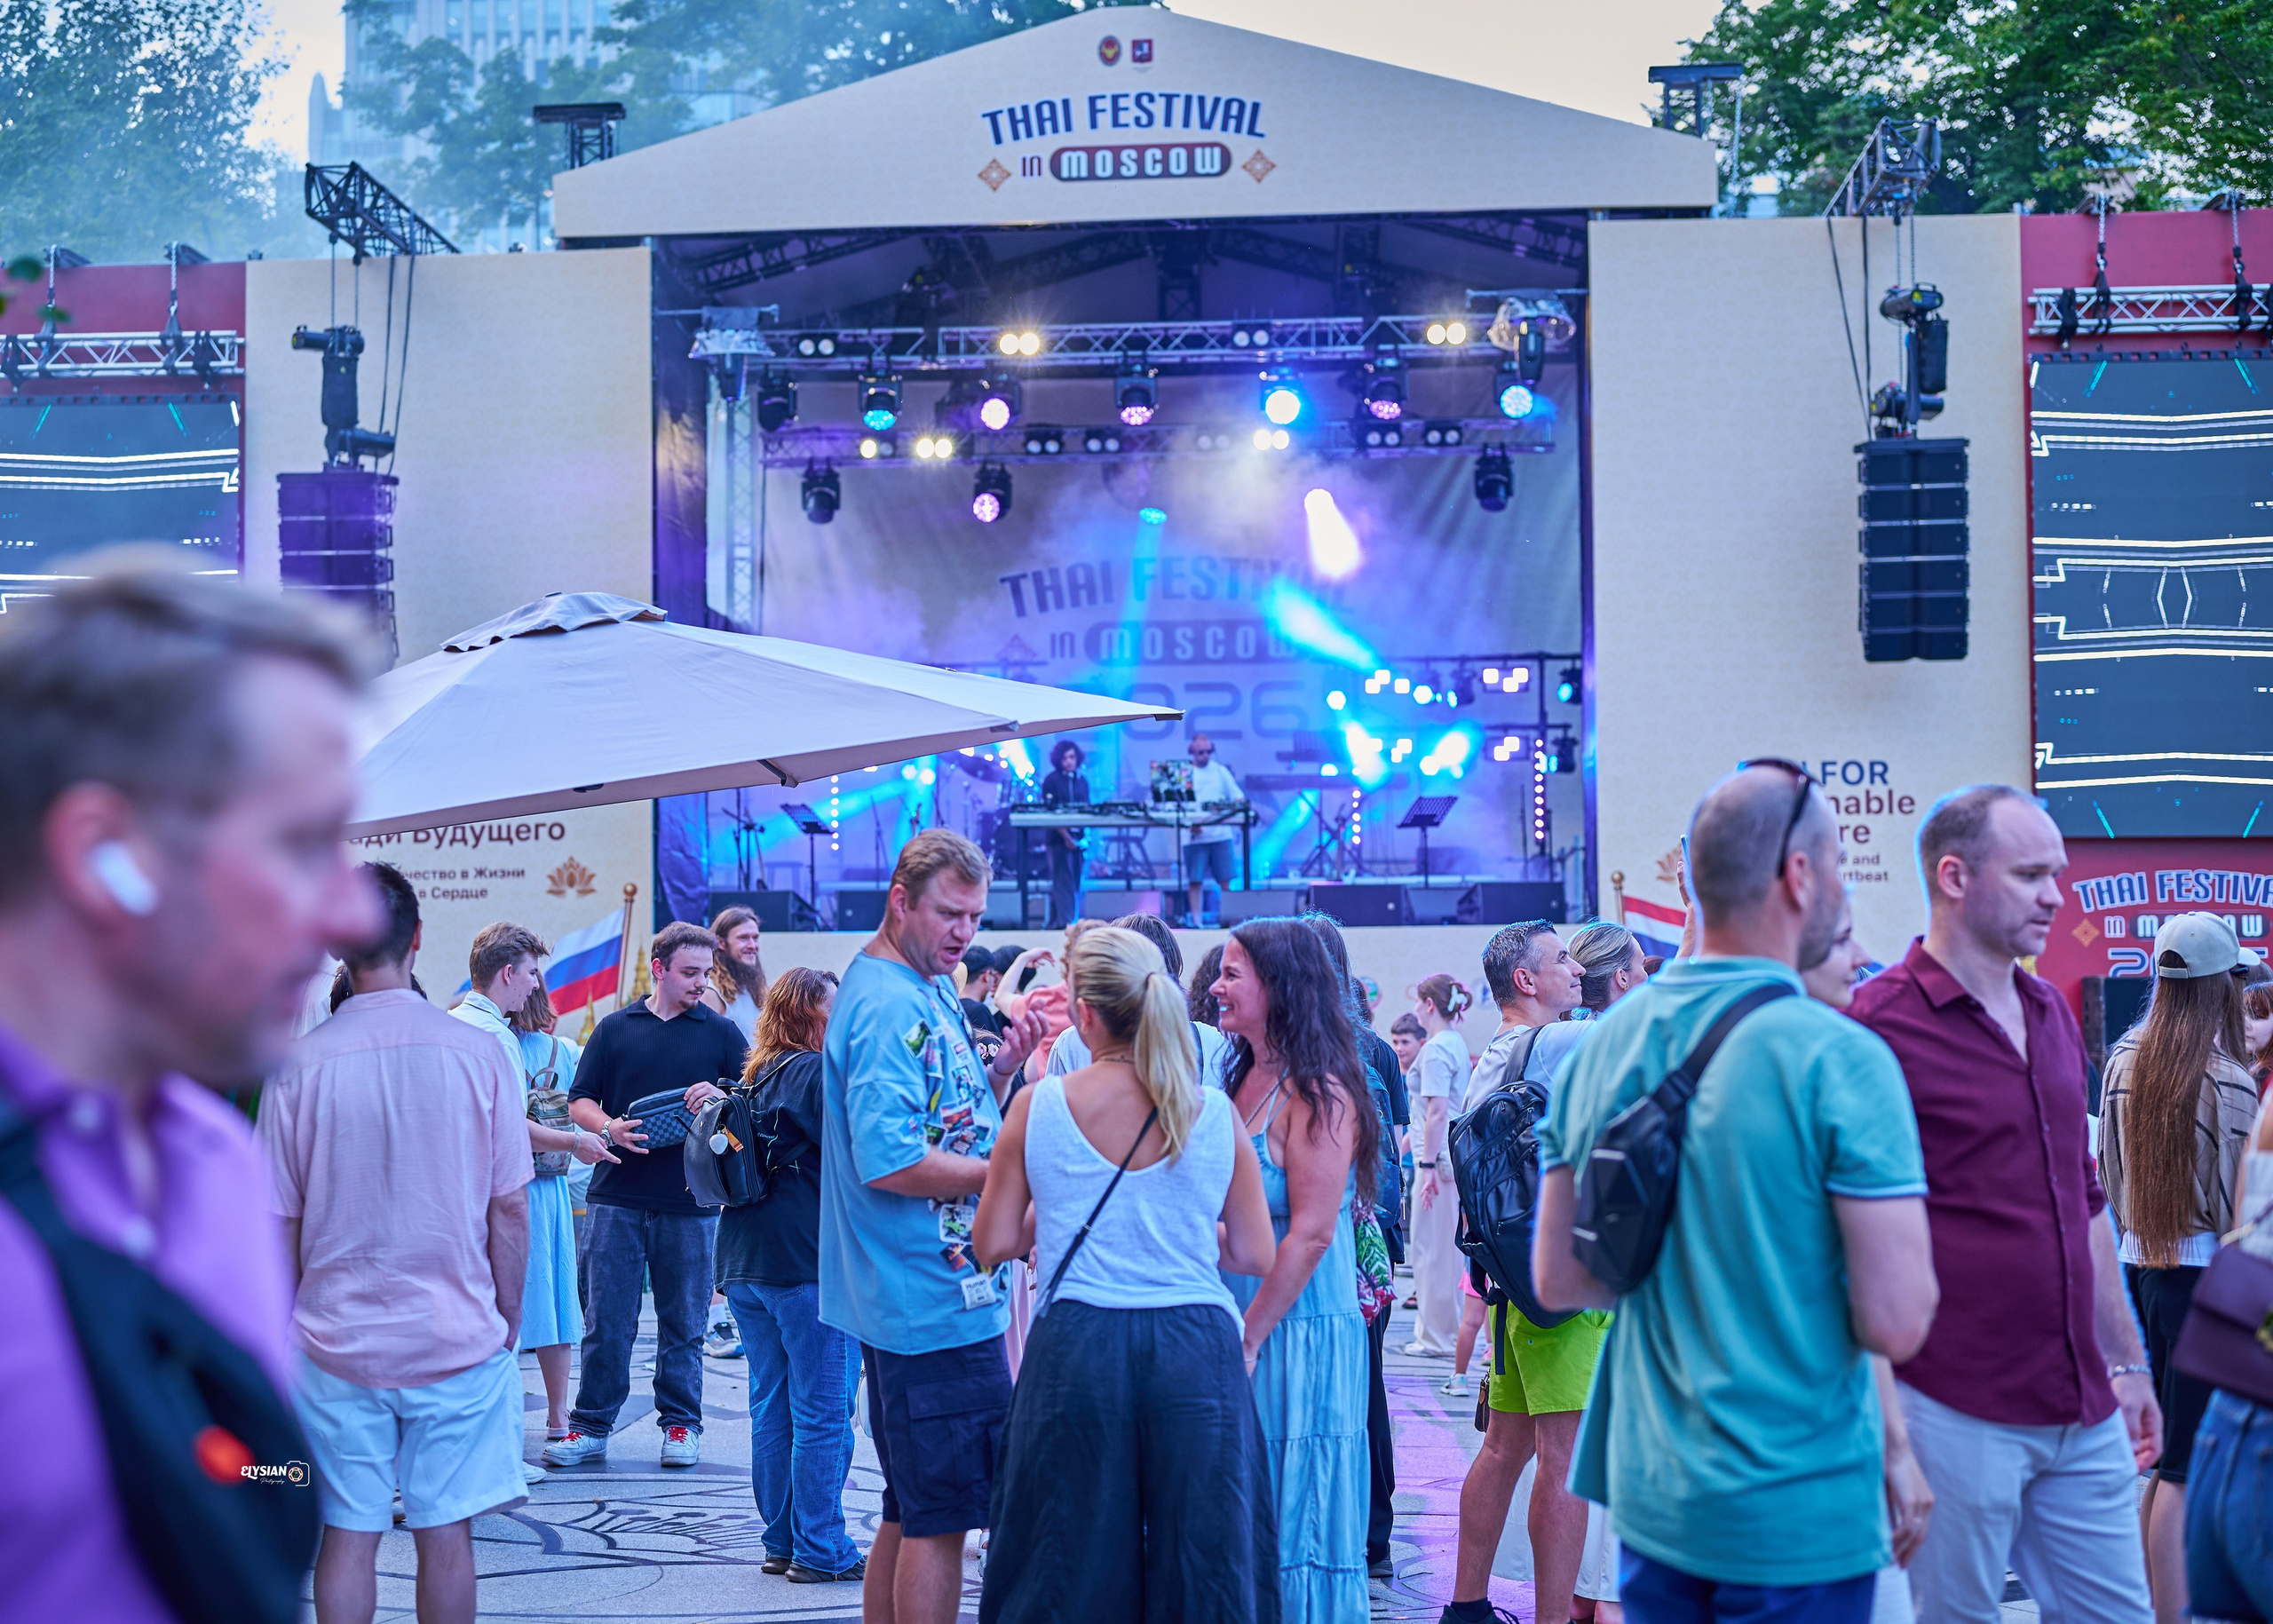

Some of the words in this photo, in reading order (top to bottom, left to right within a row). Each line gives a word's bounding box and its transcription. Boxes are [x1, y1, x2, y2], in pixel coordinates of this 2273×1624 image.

[981, 99, 1073, 145] THAI
[1089, 92, 1265, 138] FESTIVAL
[1060, 147, 1222, 178] MOSCOW
[999, 560, 1114, 617] THAI
[1820, 760, 1889, 785] FOR
[1829, 788, 1915, 815] nable
[1839, 824, 1870, 844] re
[1853, 853, 1881, 865] and
[405, 869, 456, 880] чество
[473, 867, 525, 879] Жизни
[1842, 870, 1889, 882] rtbeat
[432, 887, 488, 901] Сердце
[2071, 871, 2149, 913] THAI
[2155, 868, 2273, 907] FESTIVA
